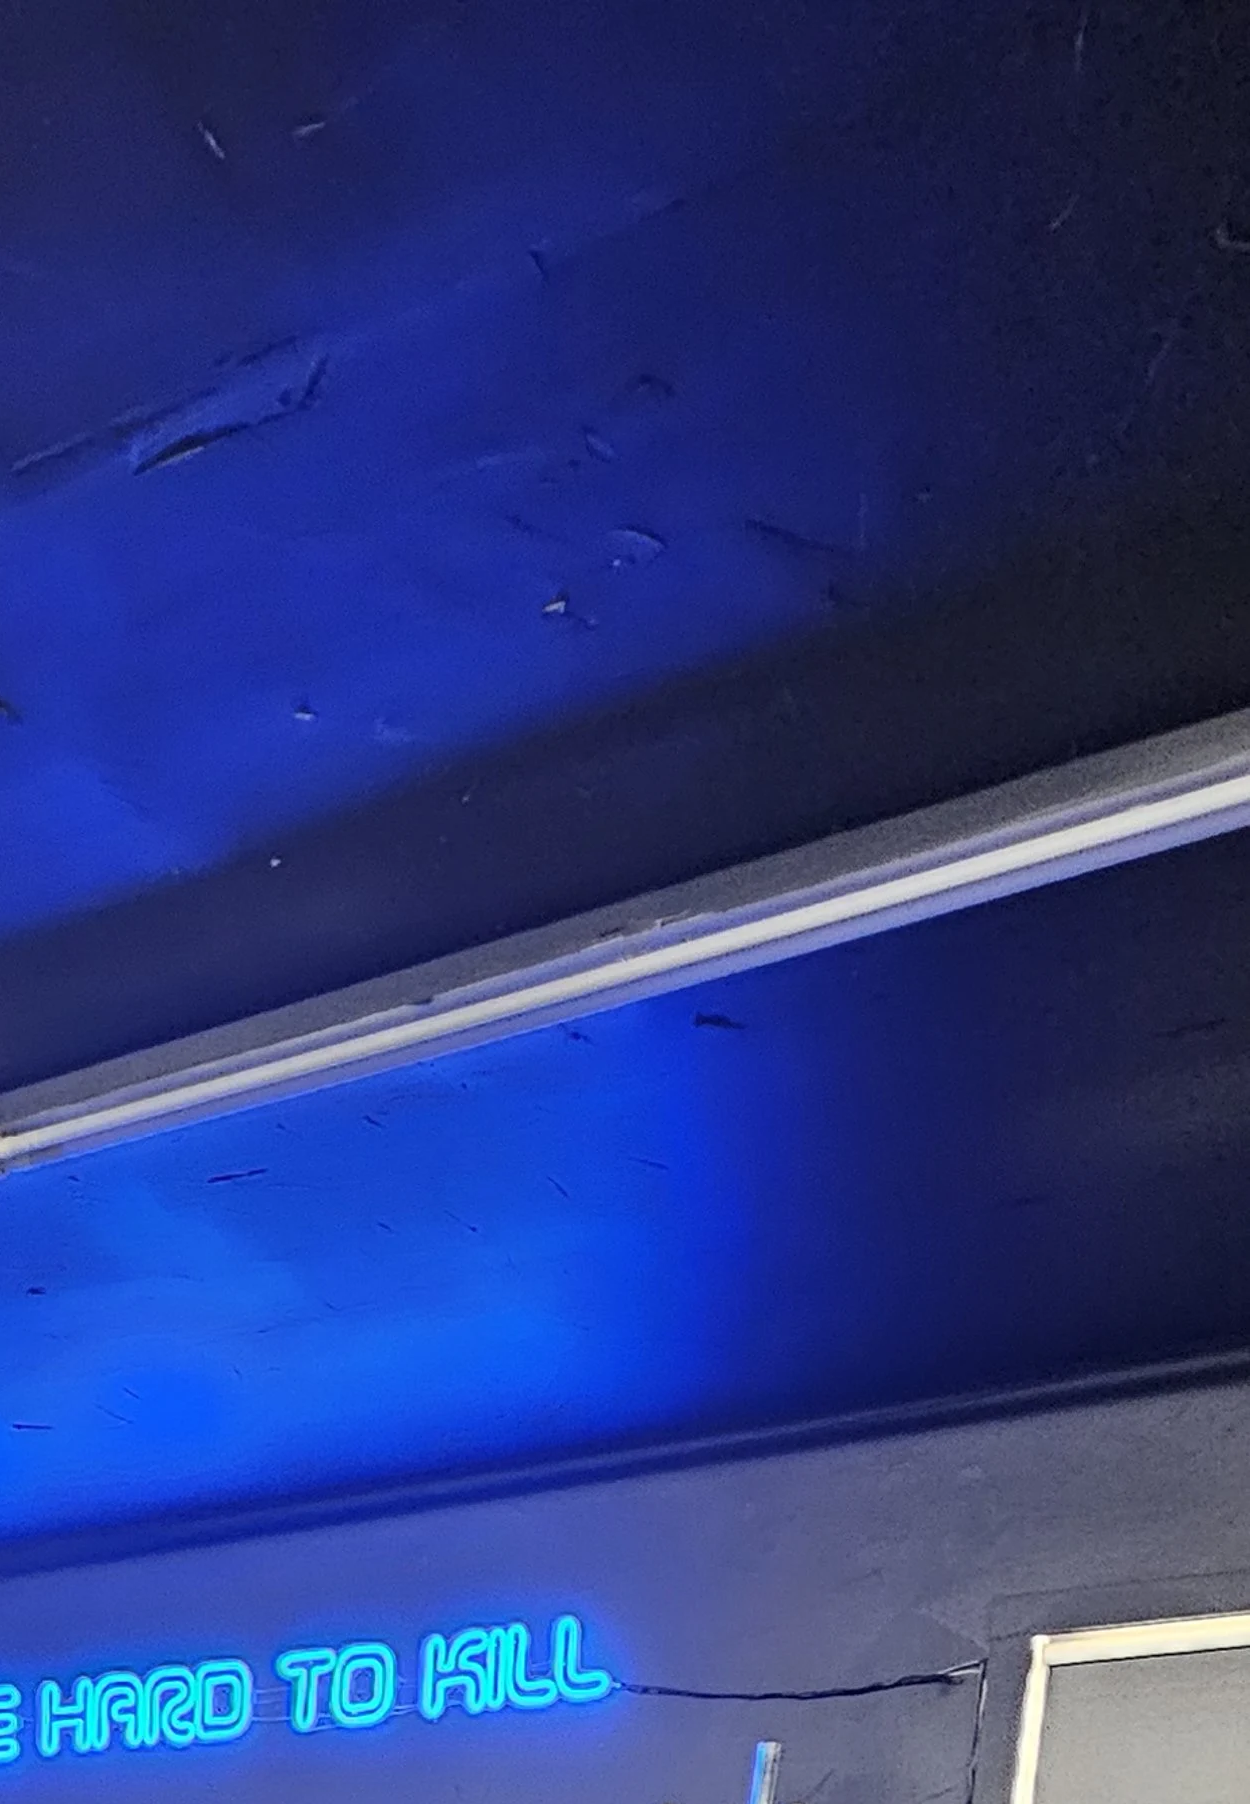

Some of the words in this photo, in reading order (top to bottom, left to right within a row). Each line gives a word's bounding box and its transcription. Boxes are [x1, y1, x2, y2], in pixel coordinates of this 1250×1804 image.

[35, 1658, 252, 1758] HARD
[277, 1641, 398, 1733] TO
[420, 1614, 614, 1721] KILL
